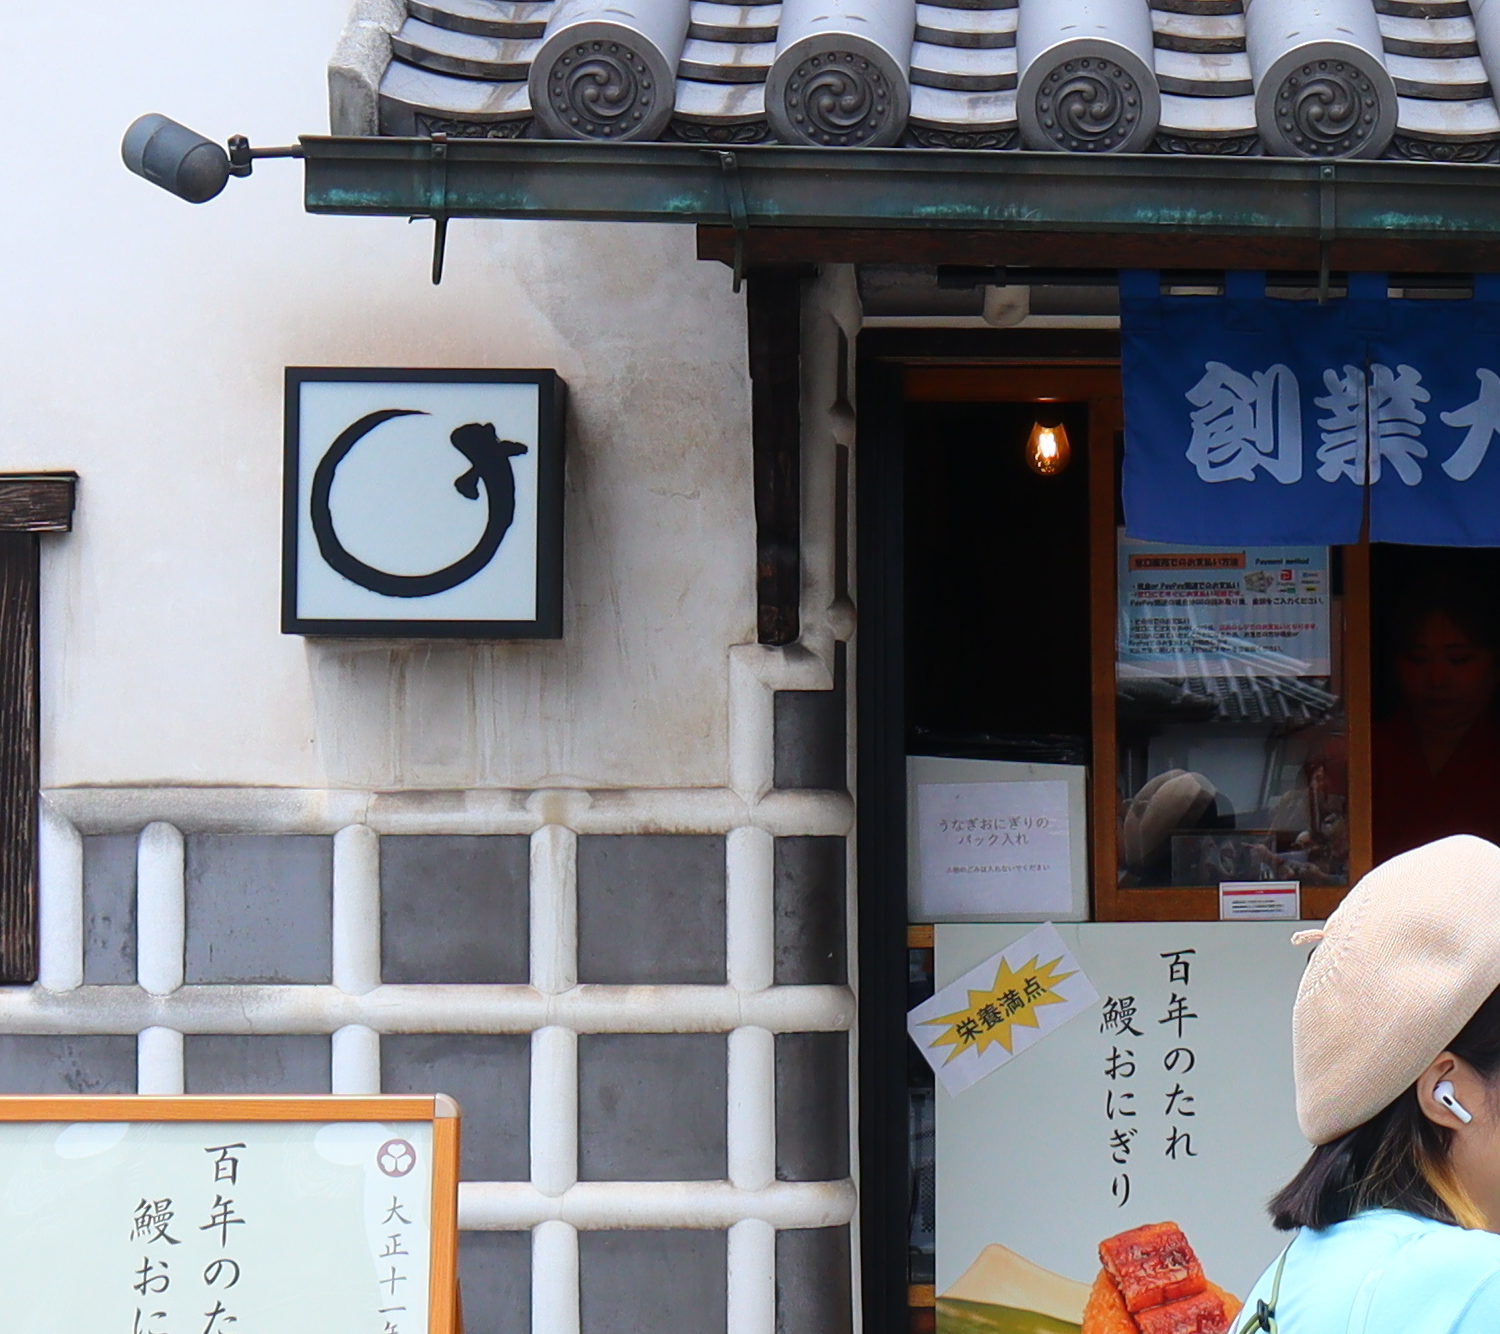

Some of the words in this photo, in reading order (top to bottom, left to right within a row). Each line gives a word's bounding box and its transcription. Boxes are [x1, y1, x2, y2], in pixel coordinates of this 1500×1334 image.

[938, 814, 1050, 835] うなぎおにぎりの
[958, 831, 1030, 847] パック入れ
[955, 975, 1047, 1045] 栄養満点
[1158, 949, 1199, 1160] 百年のたれ
[1100, 995, 1145, 1208] 鰻おにぎり
